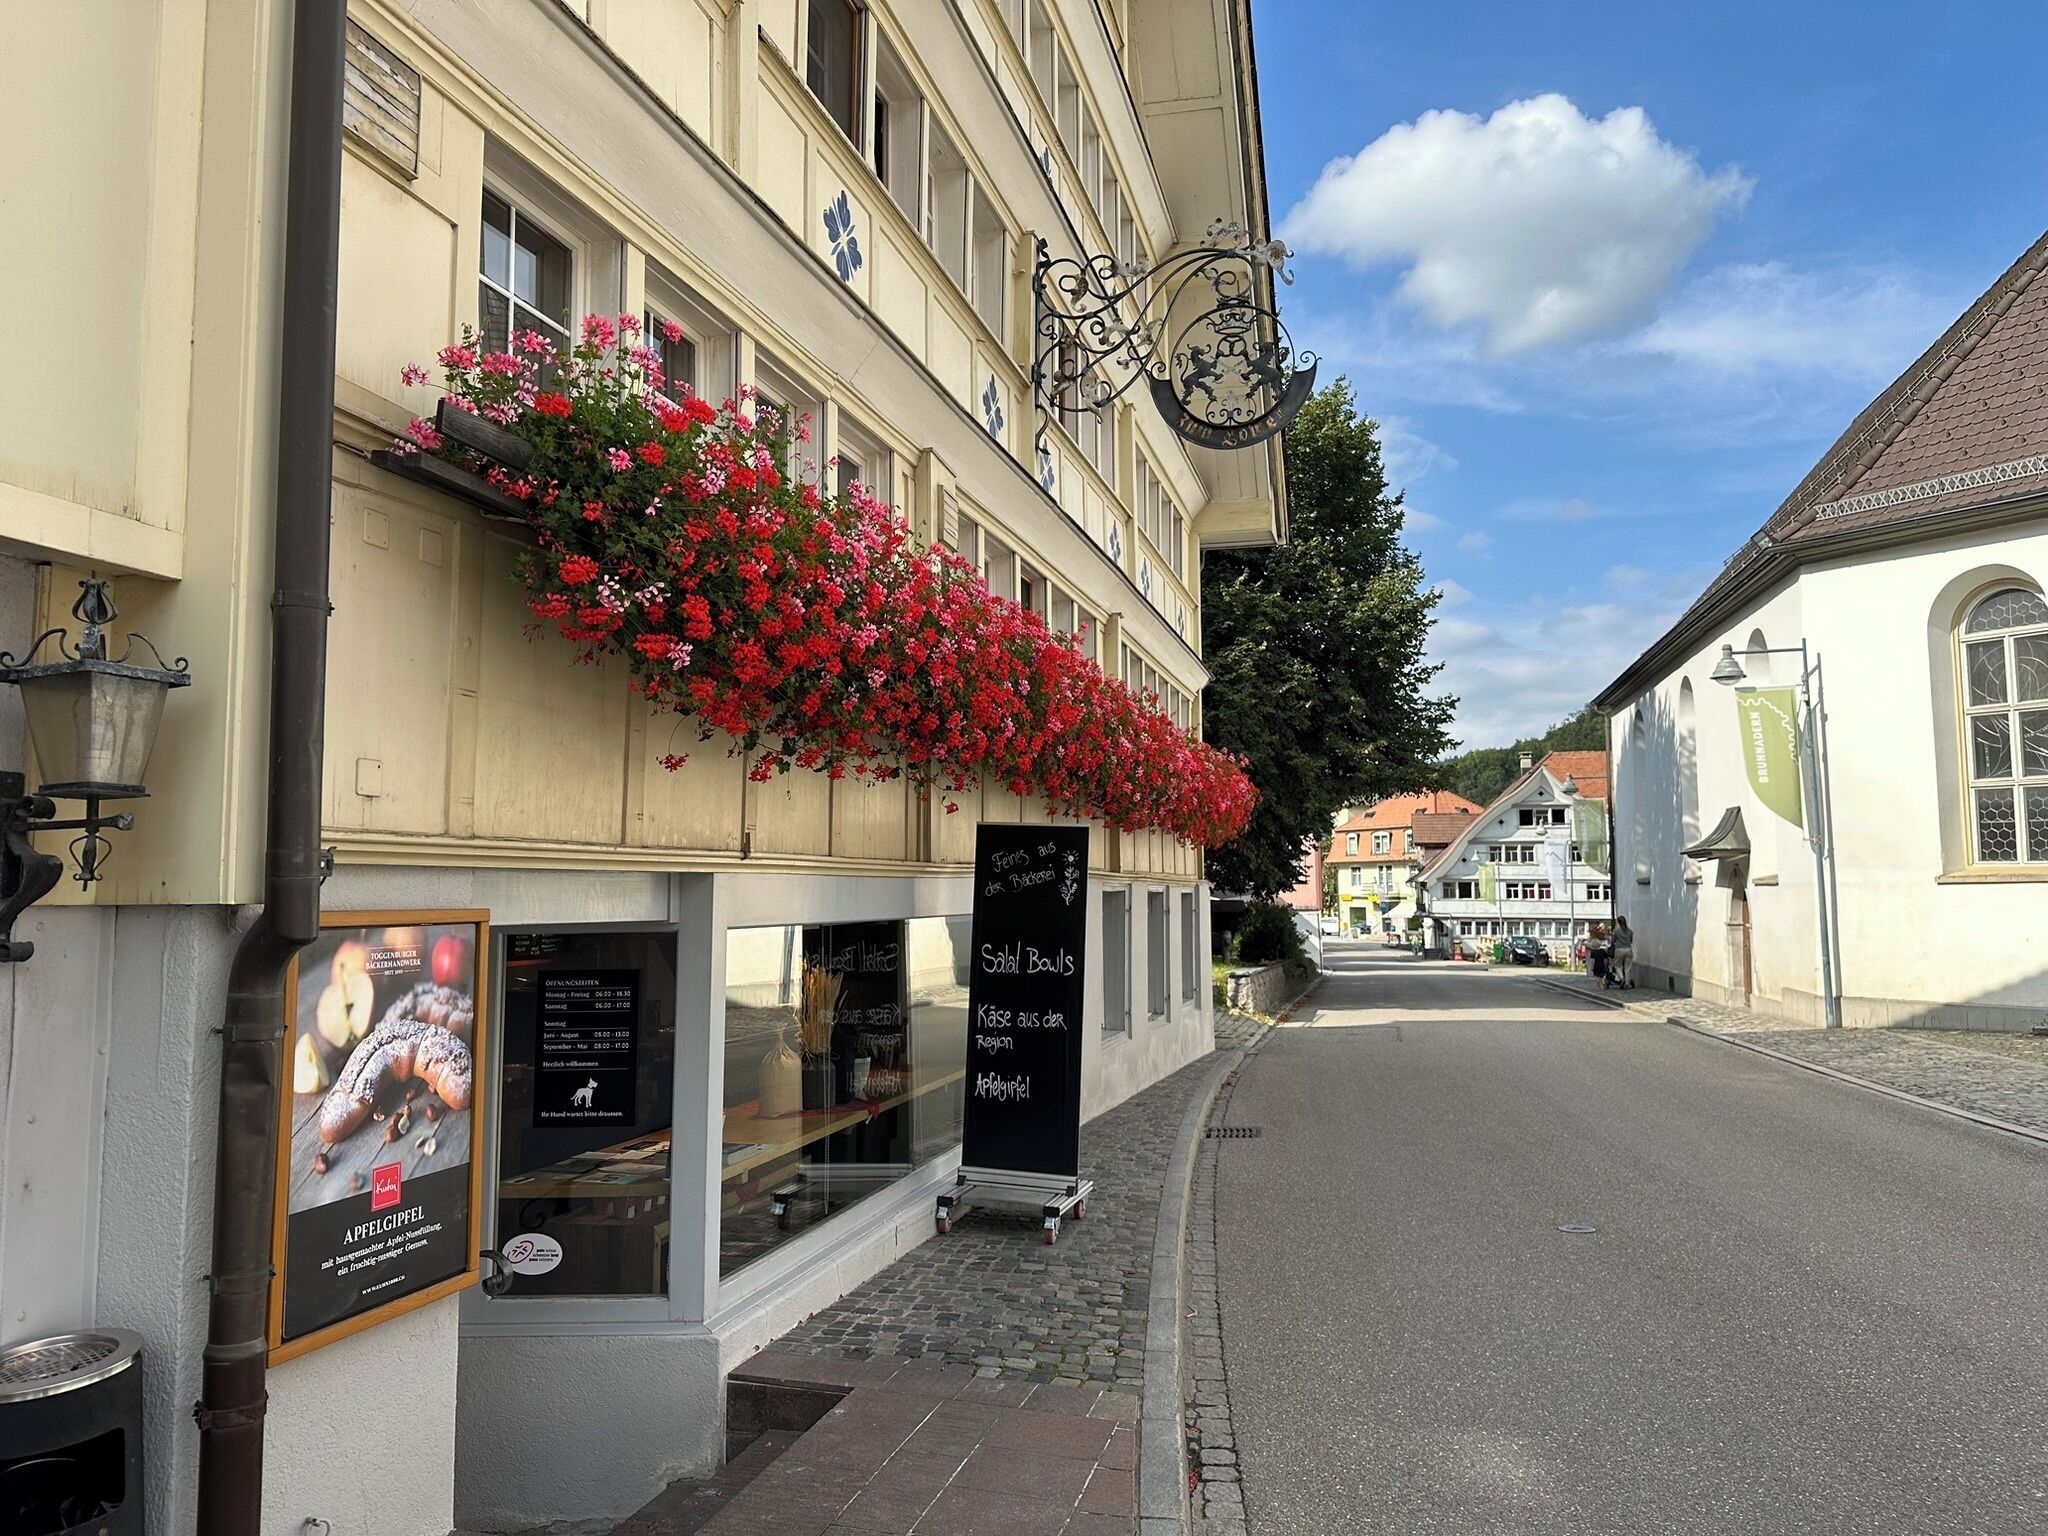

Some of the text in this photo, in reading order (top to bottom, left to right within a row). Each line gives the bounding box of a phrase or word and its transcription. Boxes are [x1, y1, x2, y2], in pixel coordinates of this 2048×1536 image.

[1749, 711, 1769, 783] BRUNNADERN
[992, 842, 1056, 872] Feines aus
[366, 959, 422, 970] BÄCKERHANDWERK
[371, 950, 418, 960] TOGGENBURGER
[1026, 948, 1074, 976] Bowls
[978, 1003, 1067, 1030] Käse aus der
[976, 1031, 1013, 1055] Region
[974, 1072, 1029, 1102] Apfelgipfel
[343, 1206, 425, 1245] APFELGIPFEL
[321, 1258, 334, 1270] mit
[336, 1242, 385, 1265] hausgemachter
[337, 1267, 348, 1276] ein
[350, 1246, 404, 1272] fruchtig-nussiger
